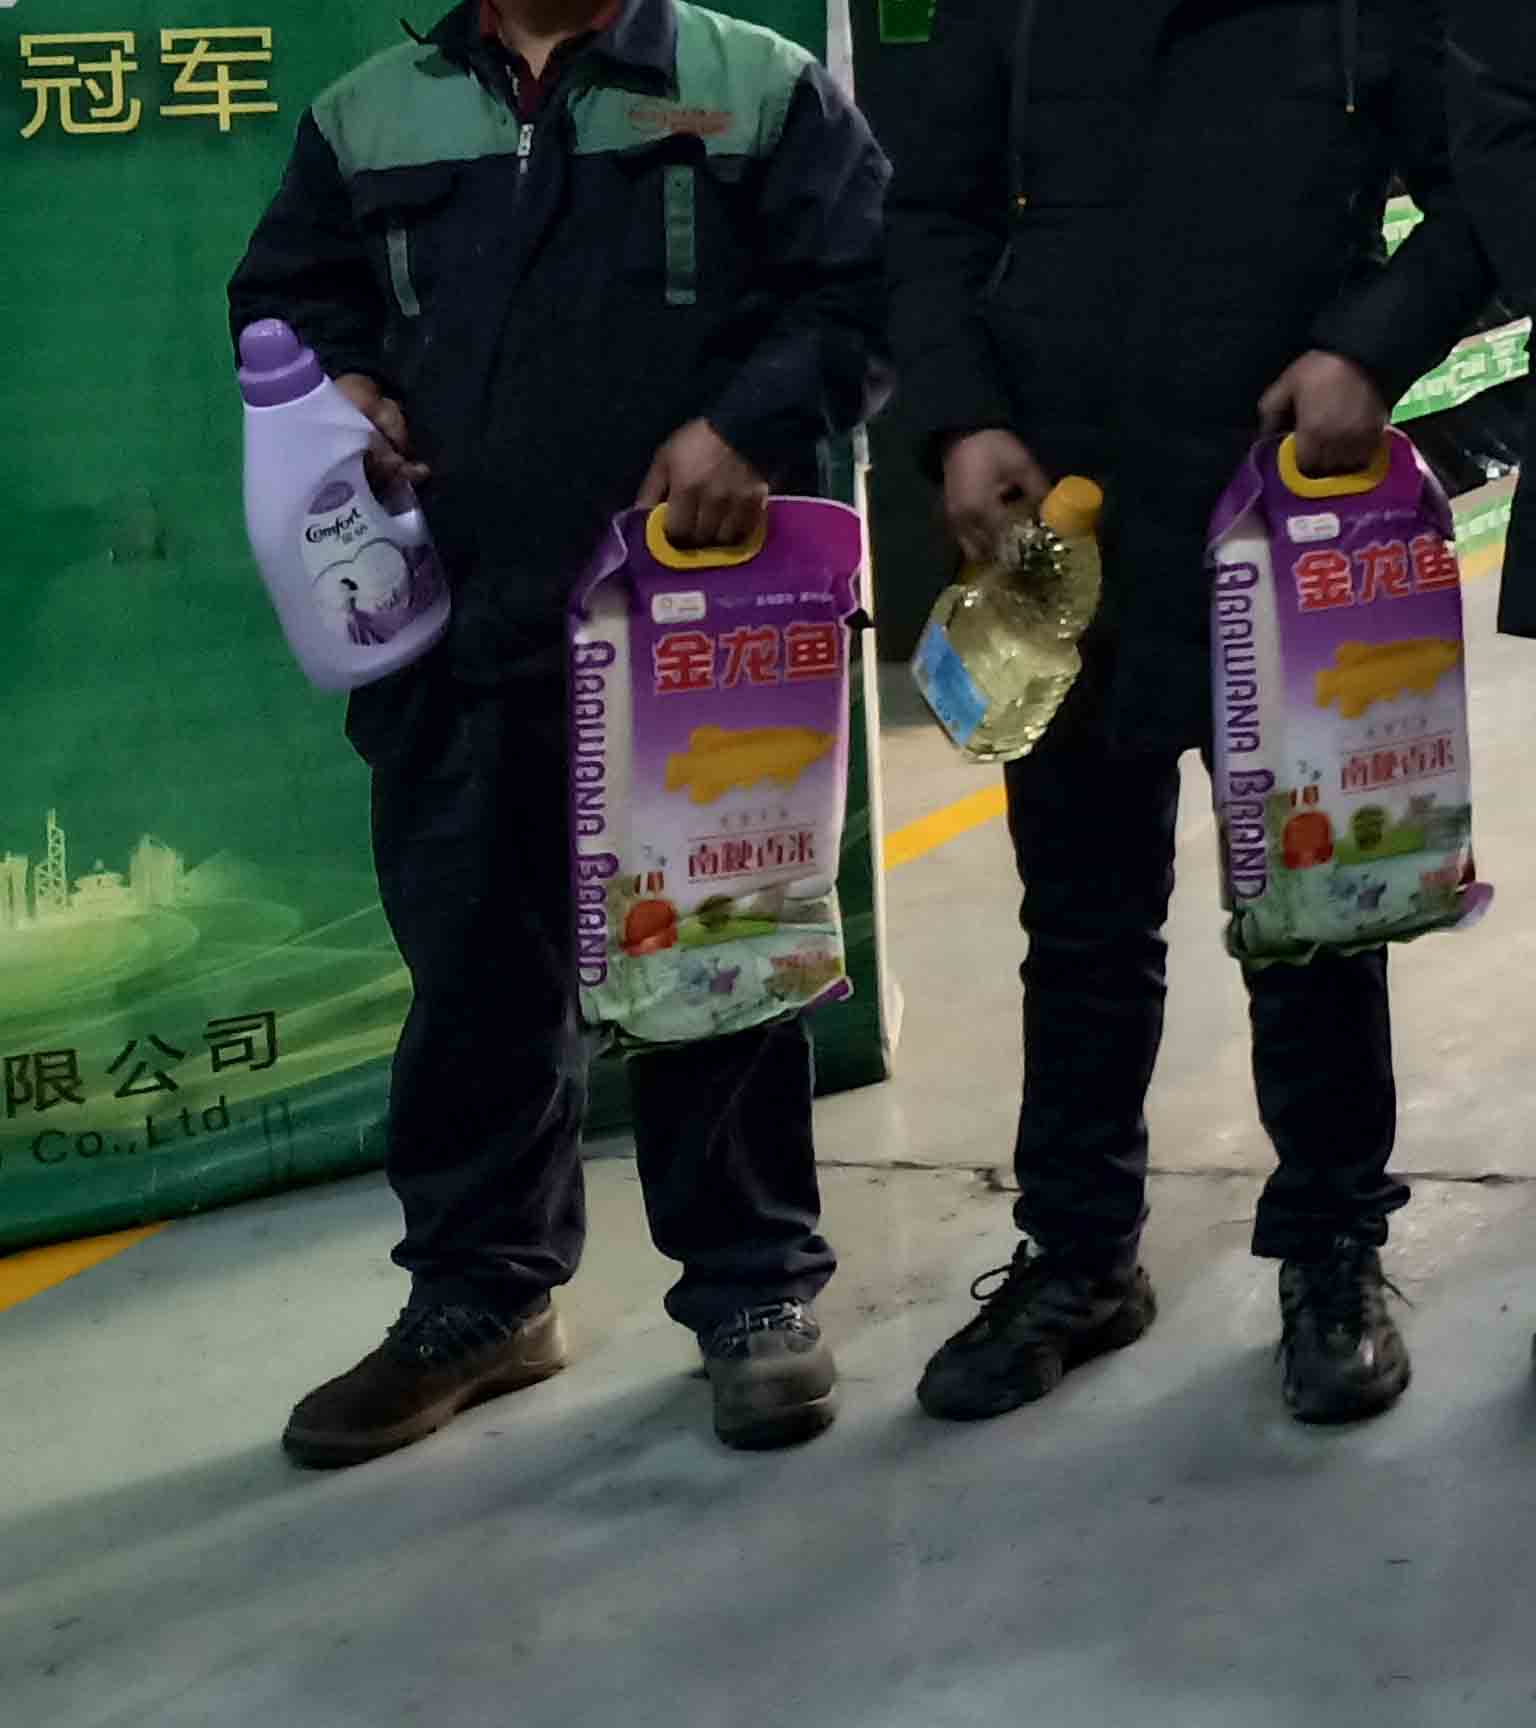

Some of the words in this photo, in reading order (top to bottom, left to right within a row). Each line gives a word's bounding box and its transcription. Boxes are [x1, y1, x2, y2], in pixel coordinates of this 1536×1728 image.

[20, 27, 278, 138] 冠军
[305, 508, 361, 543] Comfort
[1294, 534, 1459, 613] 金龙鱼
[655, 622, 839, 696] 金龙鱼
[2, 1010, 278, 1119] 限公司
